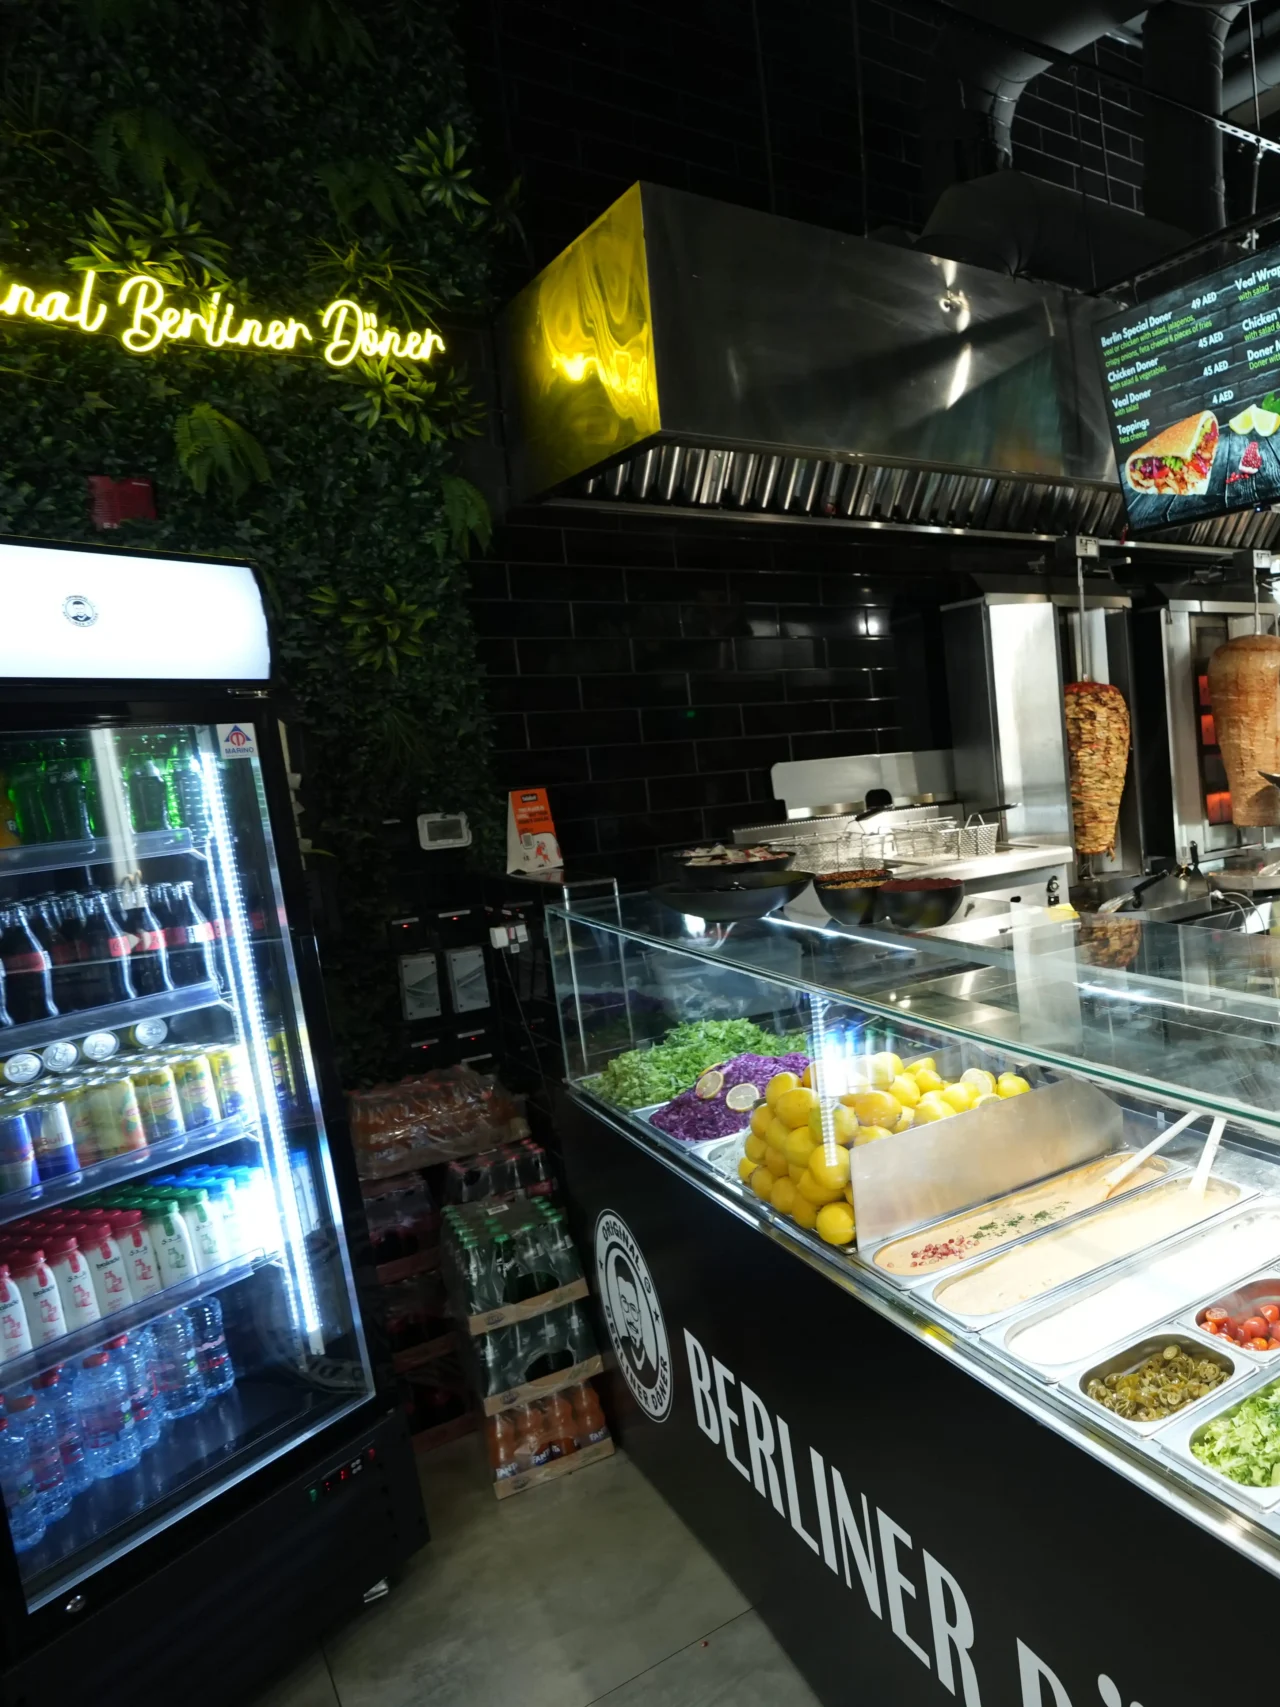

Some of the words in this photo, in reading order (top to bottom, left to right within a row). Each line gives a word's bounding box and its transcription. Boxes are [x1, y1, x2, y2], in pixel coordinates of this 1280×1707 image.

[1235, 273, 1256, 290] Veal
[1191, 298, 1201, 309] 49
[1202, 292, 1219, 305] AED
[1238, 290, 1252, 301] with
[1253, 283, 1269, 295] salad
[118, 275, 312, 353] Berliner
[322, 298, 446, 367] Döner
[1101, 332, 1122, 347] Berlin
[1122, 318, 1148, 339] Special
[1149, 311, 1172, 327] Doner
[1242, 313, 1277, 331] Chicken
[1198, 337, 1207, 348] 45
[1209, 331, 1223, 344] AED
[1247, 345, 1273, 361] Doner
[1107, 367, 1136, 383] Chicken
[1136, 357, 1158, 372] Doner
[1203, 365, 1212, 376] 45
[1214, 360, 1229, 373] AED
[1249, 357, 1268, 370] Doner
[1112, 393, 1129, 408] Veal
[1129, 389, 1151, 404] Doner
[1212, 395, 1218, 403] 4
[1219, 390, 1233, 403] AED
[1116, 419, 1150, 435] Toppings
[601, 1220, 642, 1272] ORIGINAL
[605, 1304, 651, 1408] BERLINER
[651, 1355, 669, 1411] DÖNER
[683, 1327, 982, 1707] BERLINER
